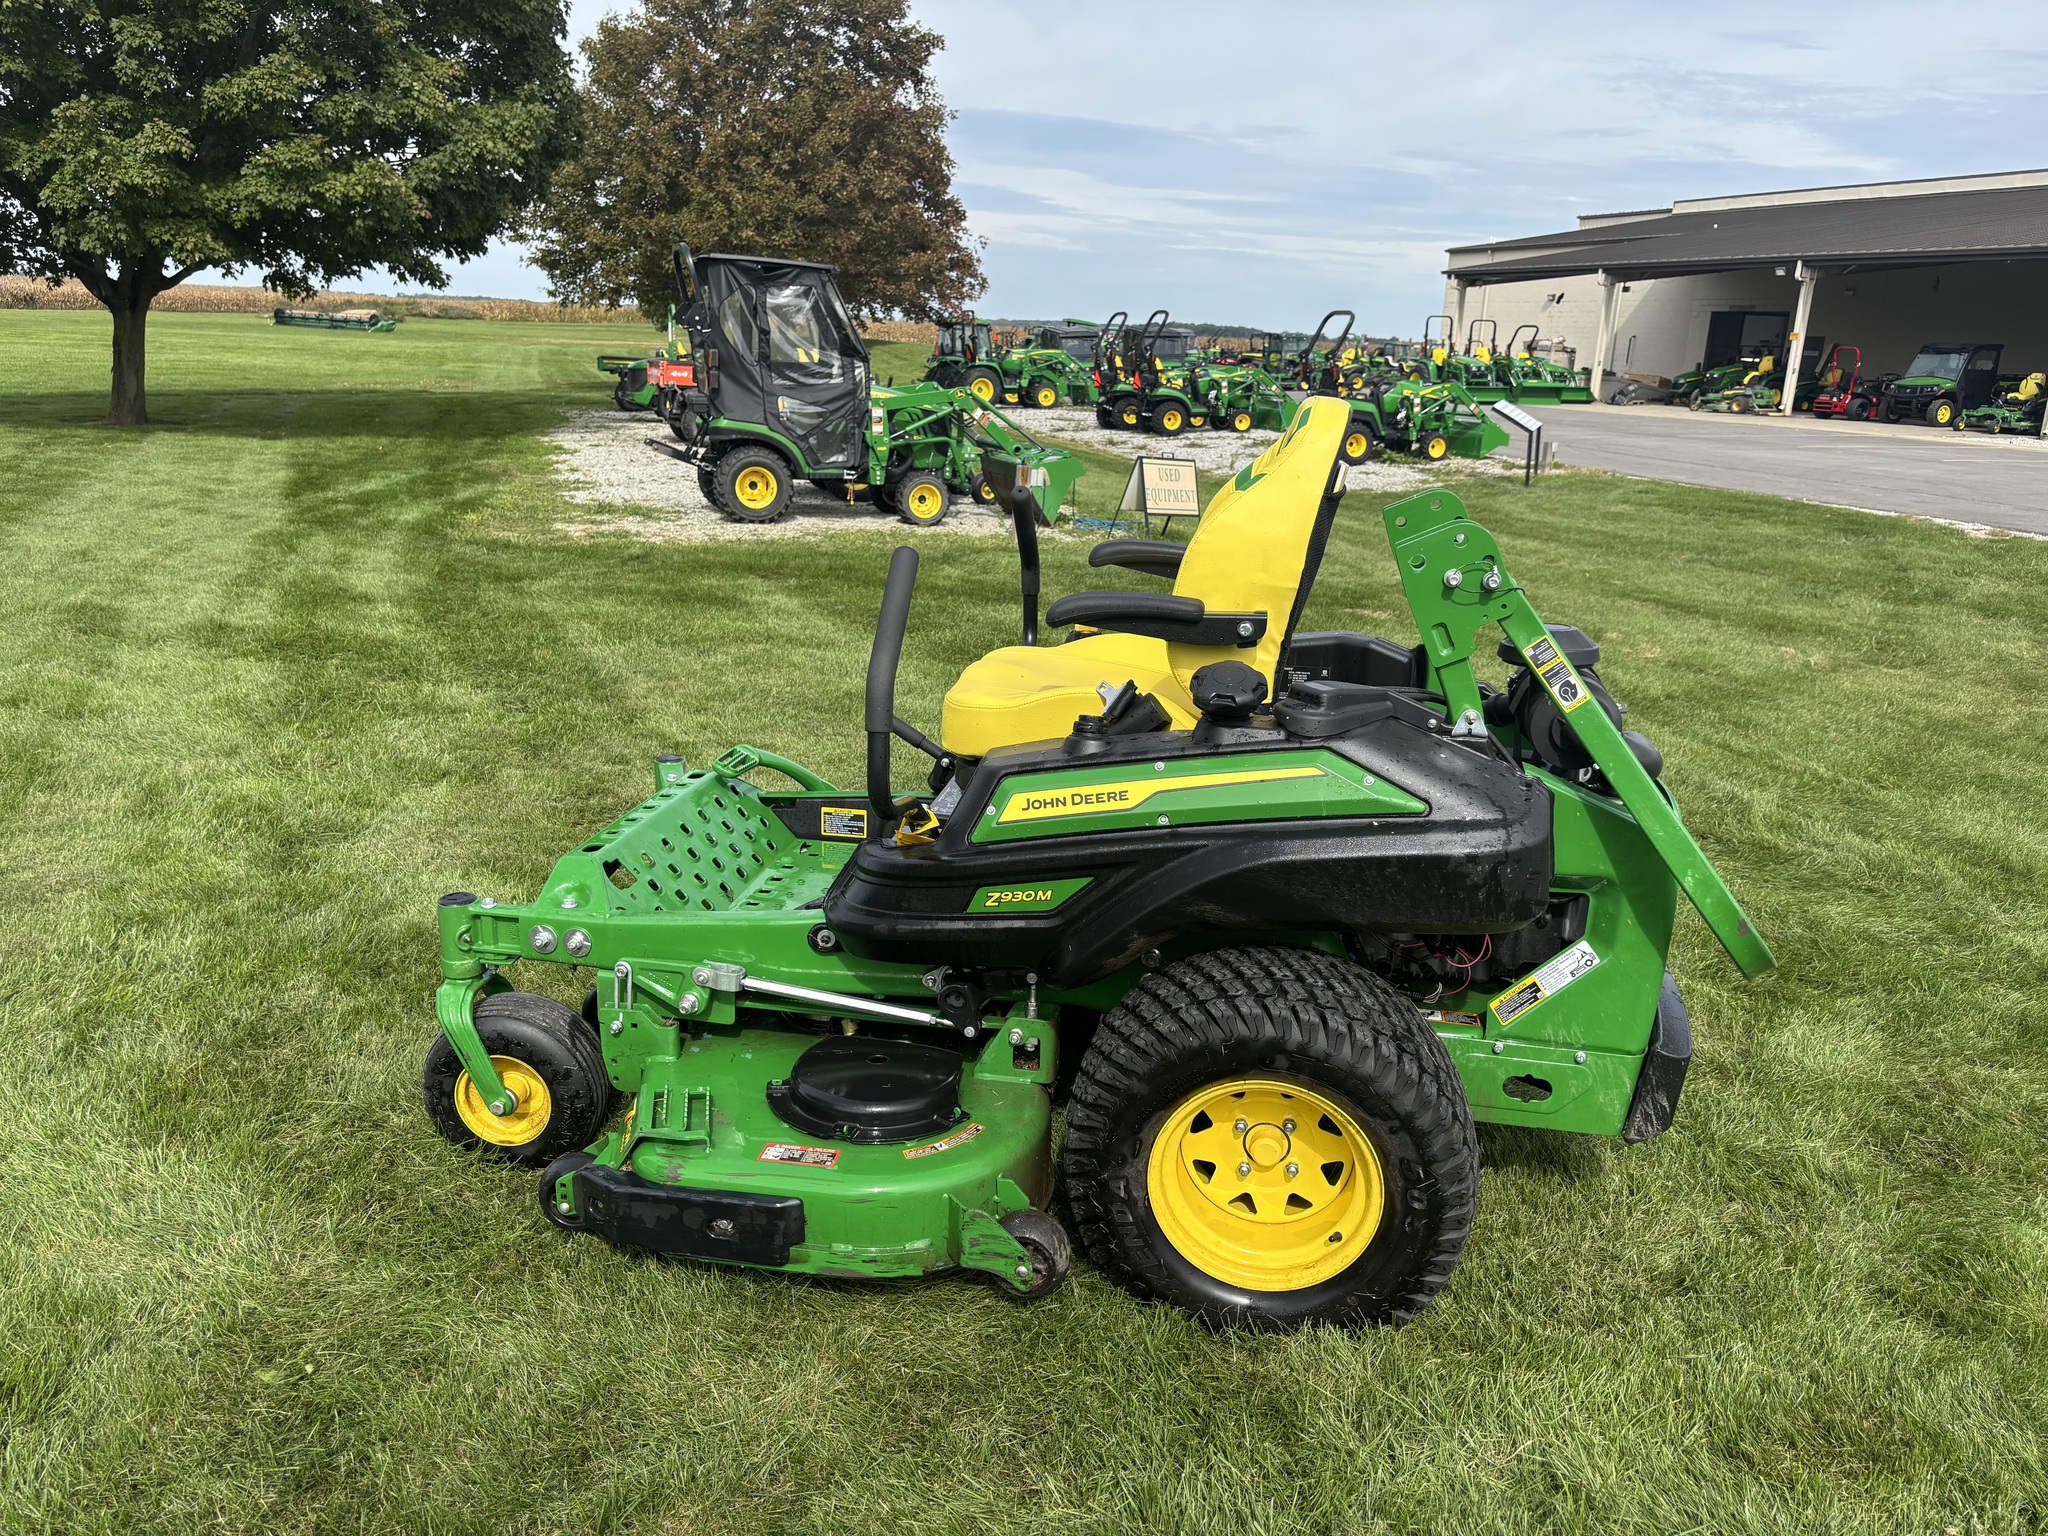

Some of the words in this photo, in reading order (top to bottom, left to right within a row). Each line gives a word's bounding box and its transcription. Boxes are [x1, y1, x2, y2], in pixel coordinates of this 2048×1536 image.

[1158, 467, 1181, 482] USED
[1145, 487, 1196, 506] EQUIPMENT
[1021, 796, 1067, 812] JOHN
[1070, 790, 1130, 806] DEERE
